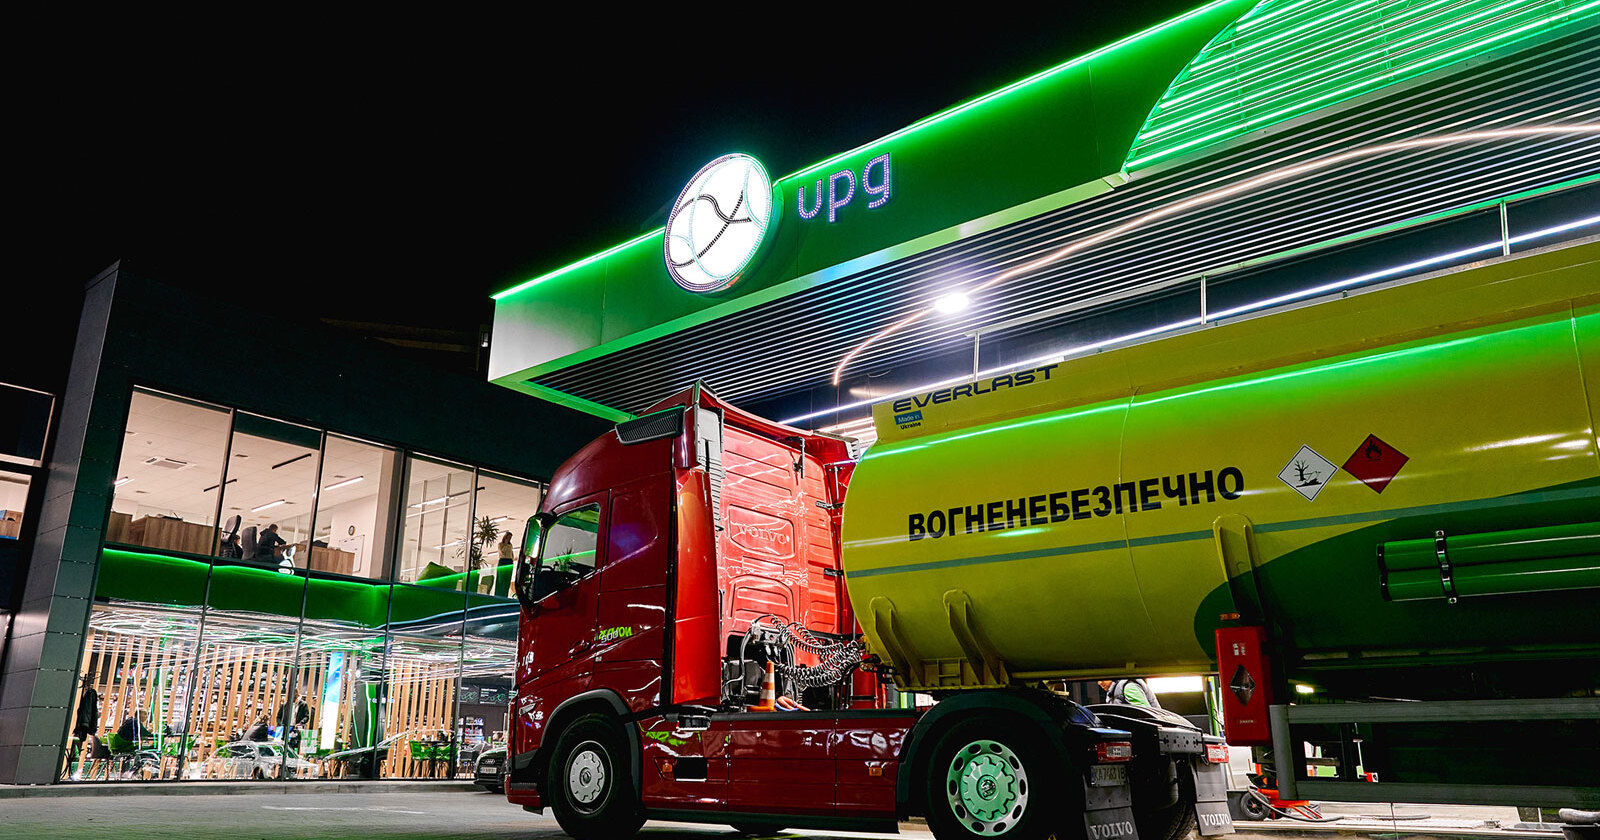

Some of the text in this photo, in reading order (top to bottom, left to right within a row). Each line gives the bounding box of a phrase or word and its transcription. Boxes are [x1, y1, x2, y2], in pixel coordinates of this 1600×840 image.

[798, 153, 890, 222] upg
[893, 364, 1058, 413] EVERLAST
[900, 421, 921, 430] Ukraine
[908, 466, 1244, 542] ВОГНЕНЕБЕЗПЕЧНО
[737, 524, 787, 545] VOLVO
[601, 630, 619, 643] 500
[1200, 814, 1230, 826] VOLVO
[1090, 821, 1133, 840] VOLVO
